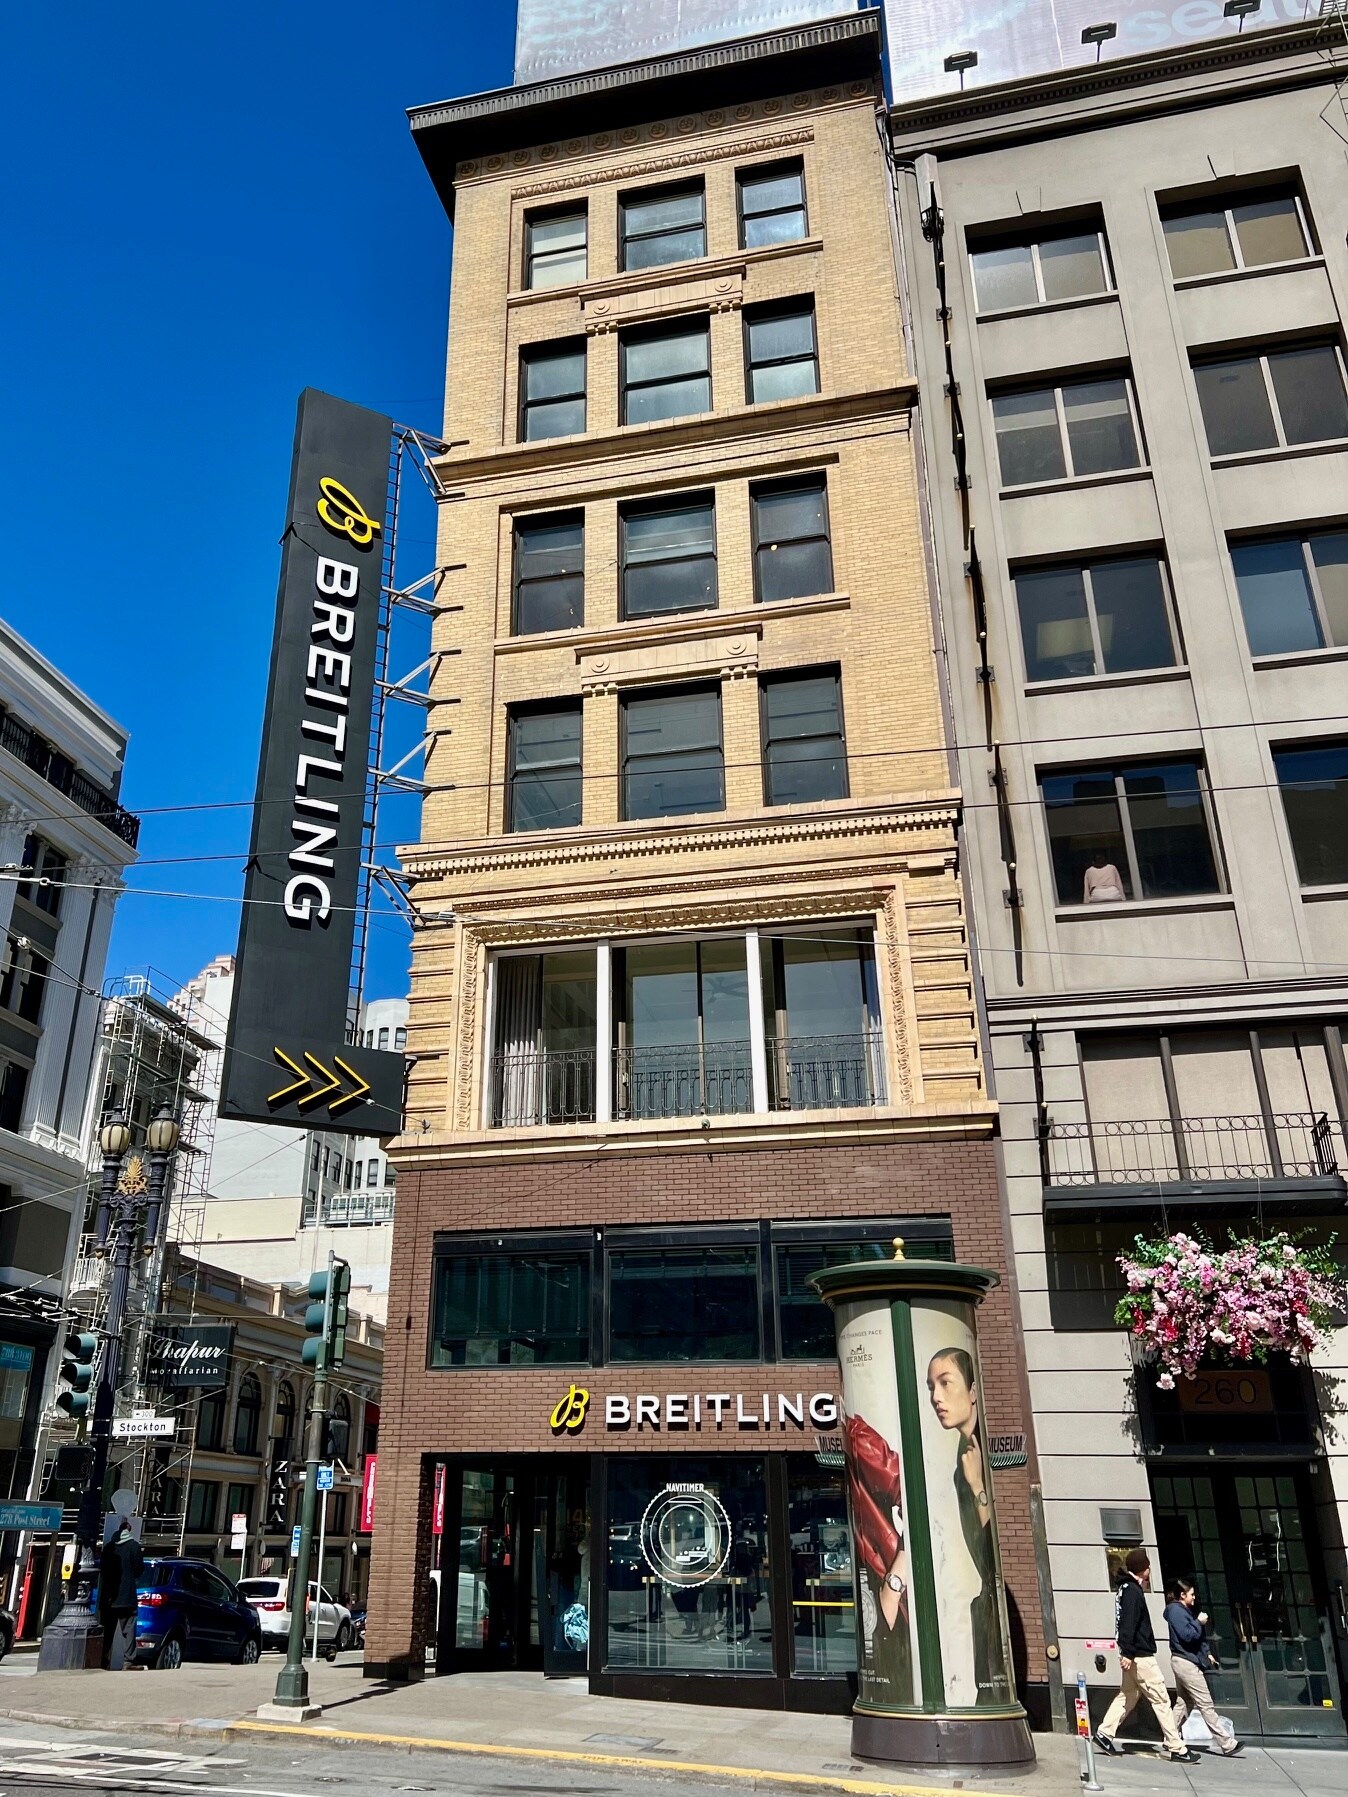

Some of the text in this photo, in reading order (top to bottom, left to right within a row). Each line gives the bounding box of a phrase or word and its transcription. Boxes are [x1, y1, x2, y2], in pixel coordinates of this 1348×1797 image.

[317, 476, 381, 544] B
[284, 555, 359, 920] BREITLING
[550, 1384, 590, 1428] B
[1194, 1379, 1257, 1405] 260
[605, 1393, 838, 1424] BREITLING
[119, 1422, 166, 1432] Stockton
[819, 1436, 844, 1453] MUSE
[988, 1435, 1024, 1454] MUSEUM
[269, 1460, 289, 1522] ZARA
[665, 1483, 705, 1493] NAVITIMER
